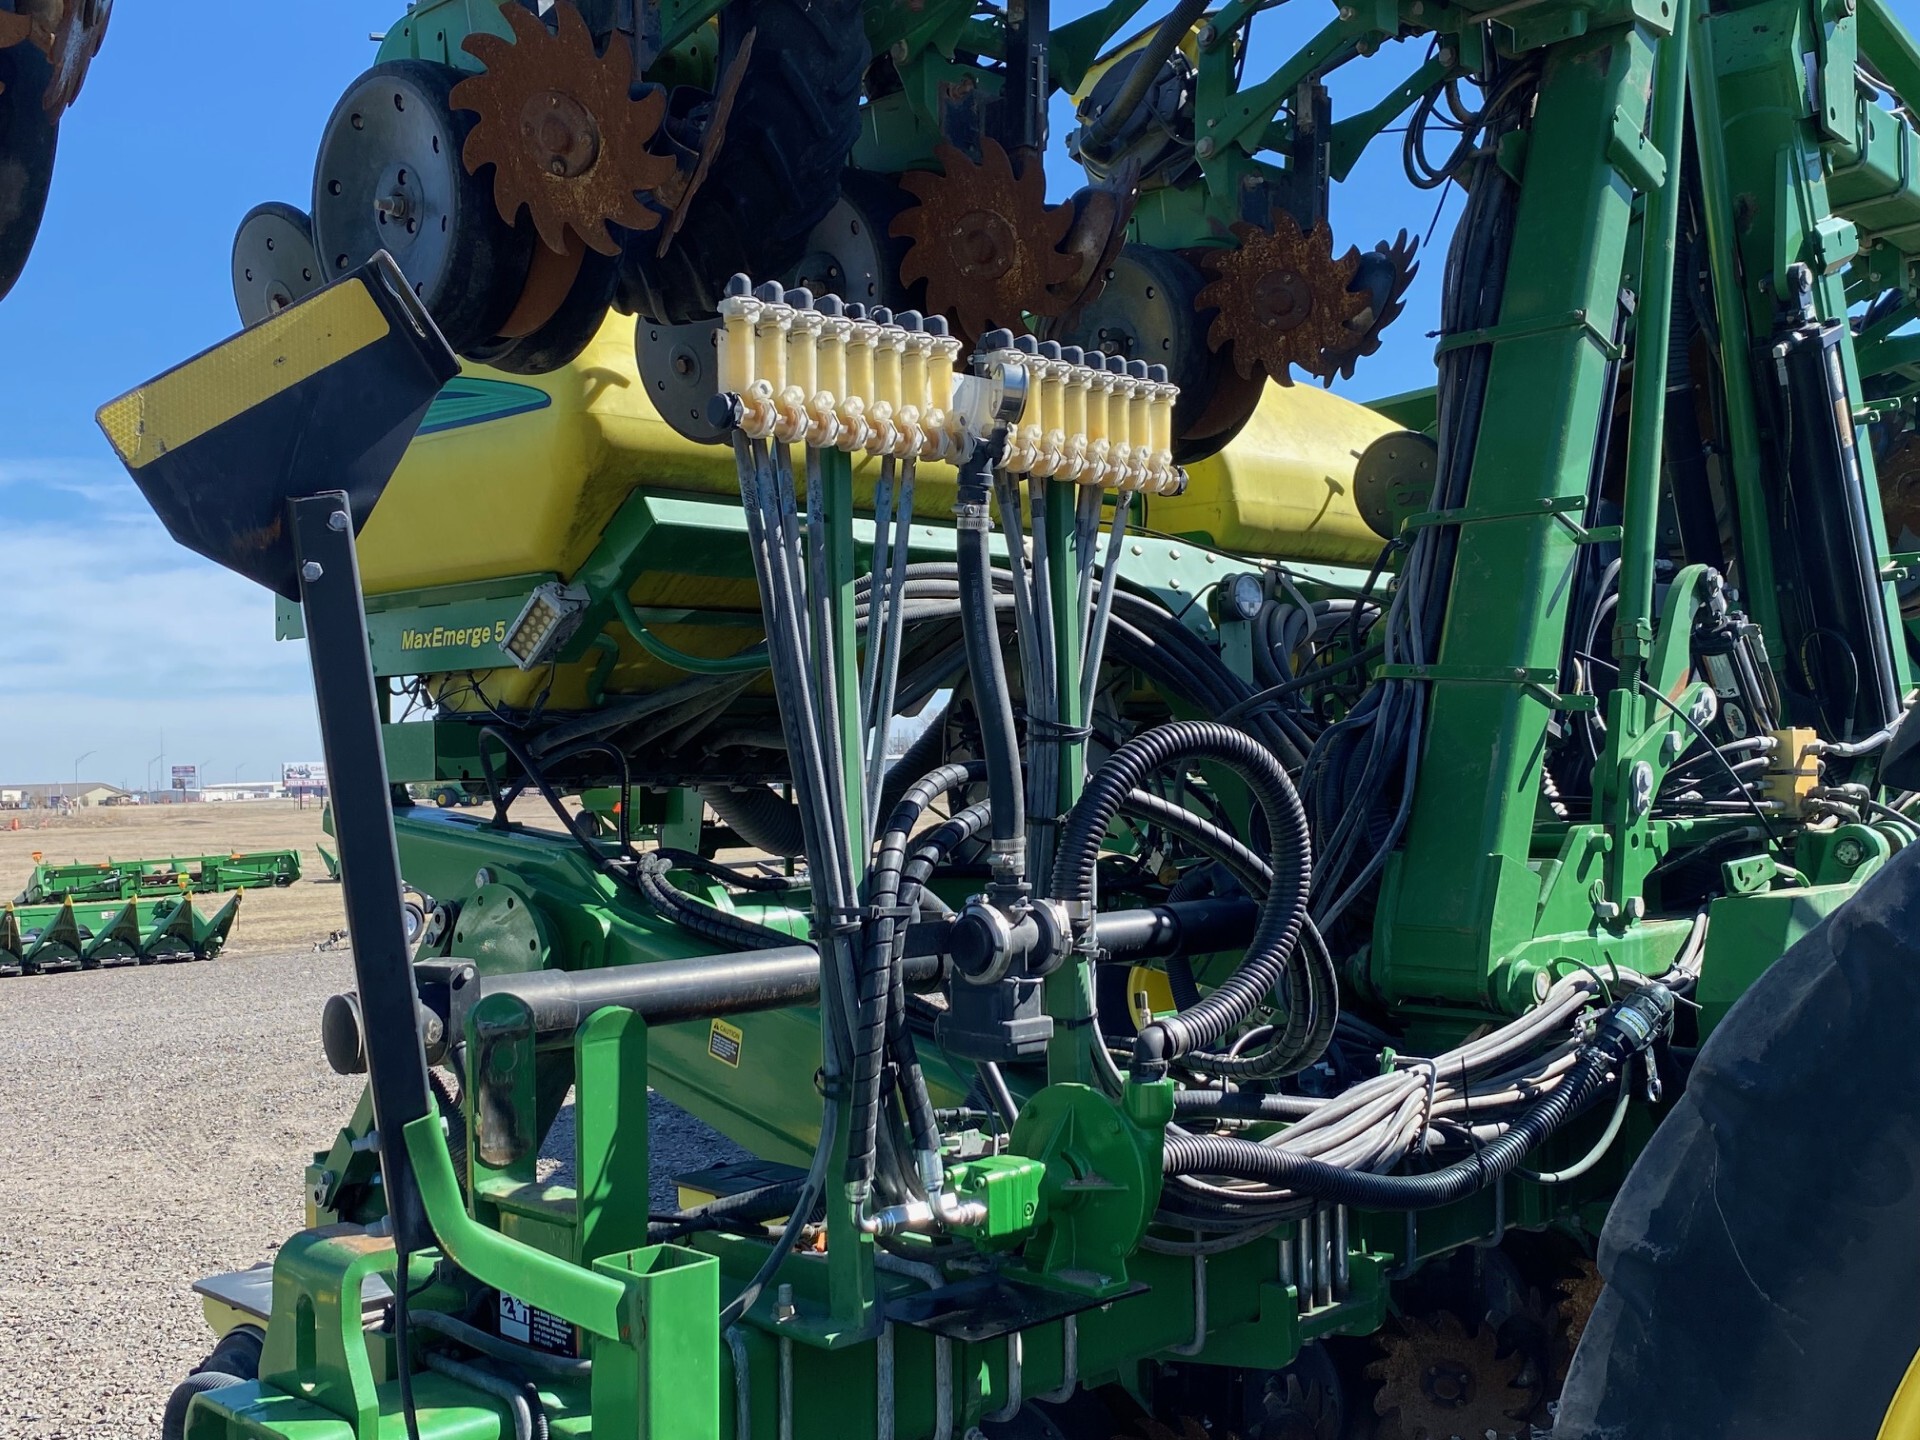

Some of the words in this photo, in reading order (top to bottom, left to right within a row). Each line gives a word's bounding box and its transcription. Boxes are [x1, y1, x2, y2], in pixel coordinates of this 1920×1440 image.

[401, 626, 491, 650] MaxEmerge
[494, 620, 506, 642] 5
[720, 1025, 740, 1040] CAUTION
